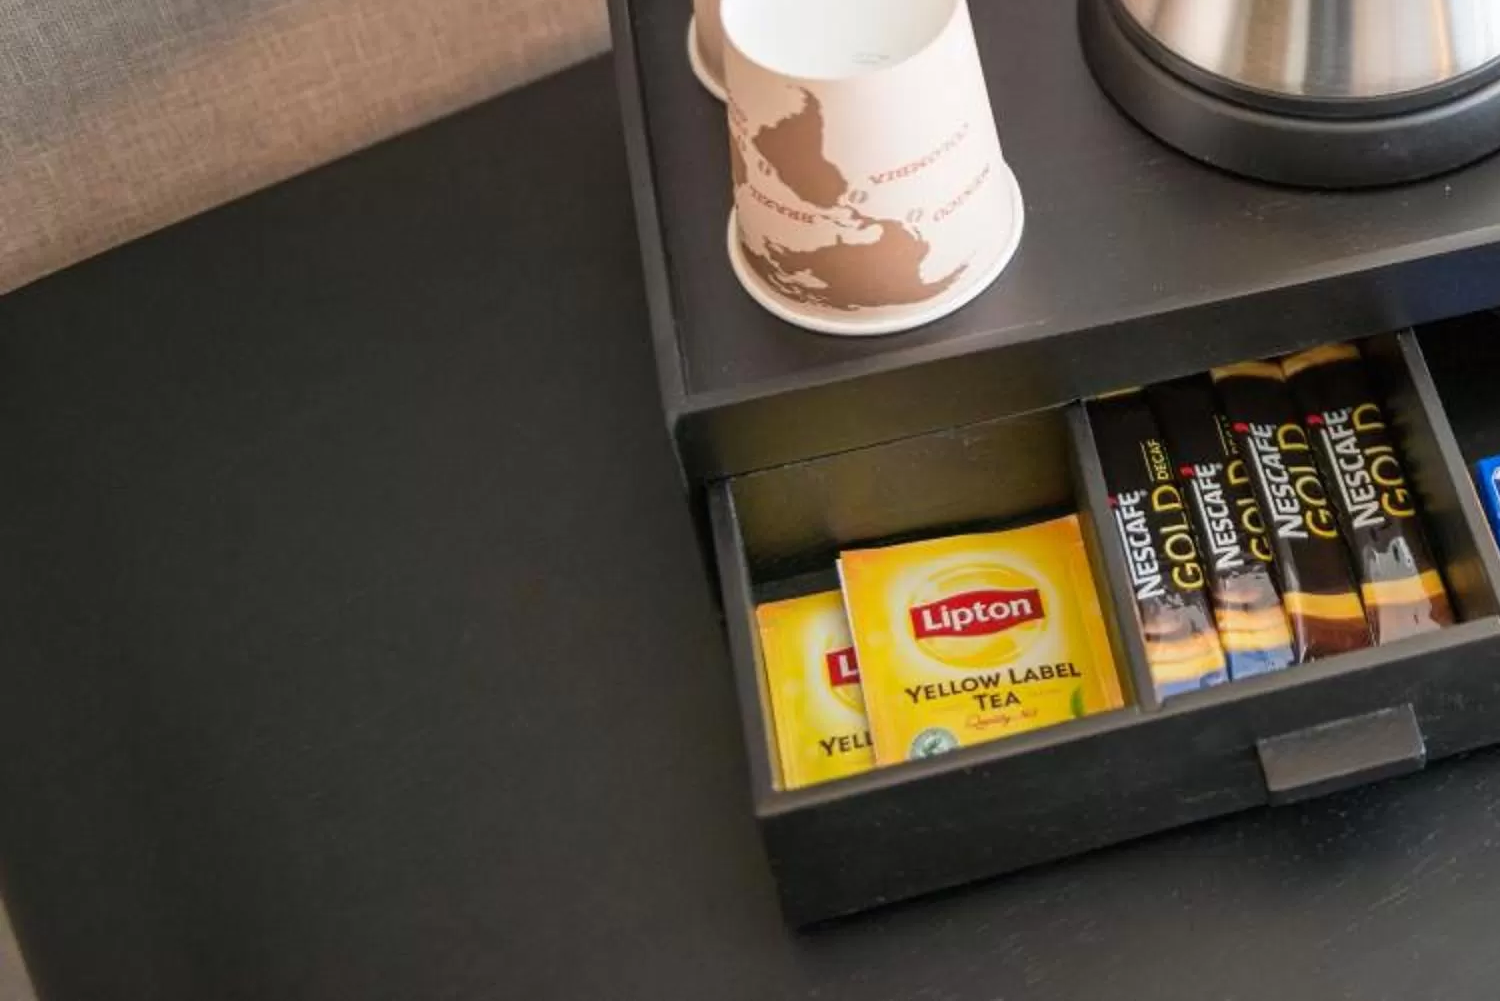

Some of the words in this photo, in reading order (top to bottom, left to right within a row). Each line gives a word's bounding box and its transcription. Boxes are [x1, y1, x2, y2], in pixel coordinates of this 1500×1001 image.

[1147, 438, 1166, 481] DECAF
[1277, 423, 1338, 539] GOLD
[1352, 402, 1415, 518] GOLD
[1226, 460, 1272, 562] GOLD
[1152, 485, 1204, 591] GOLD
[921, 598, 1033, 632] Lipton
[905, 673, 1001, 704] YELLOW
[1009, 662, 1082, 685] LABEL
[973, 691, 1021, 712] TEA
[819, 731, 873, 757] YELL
